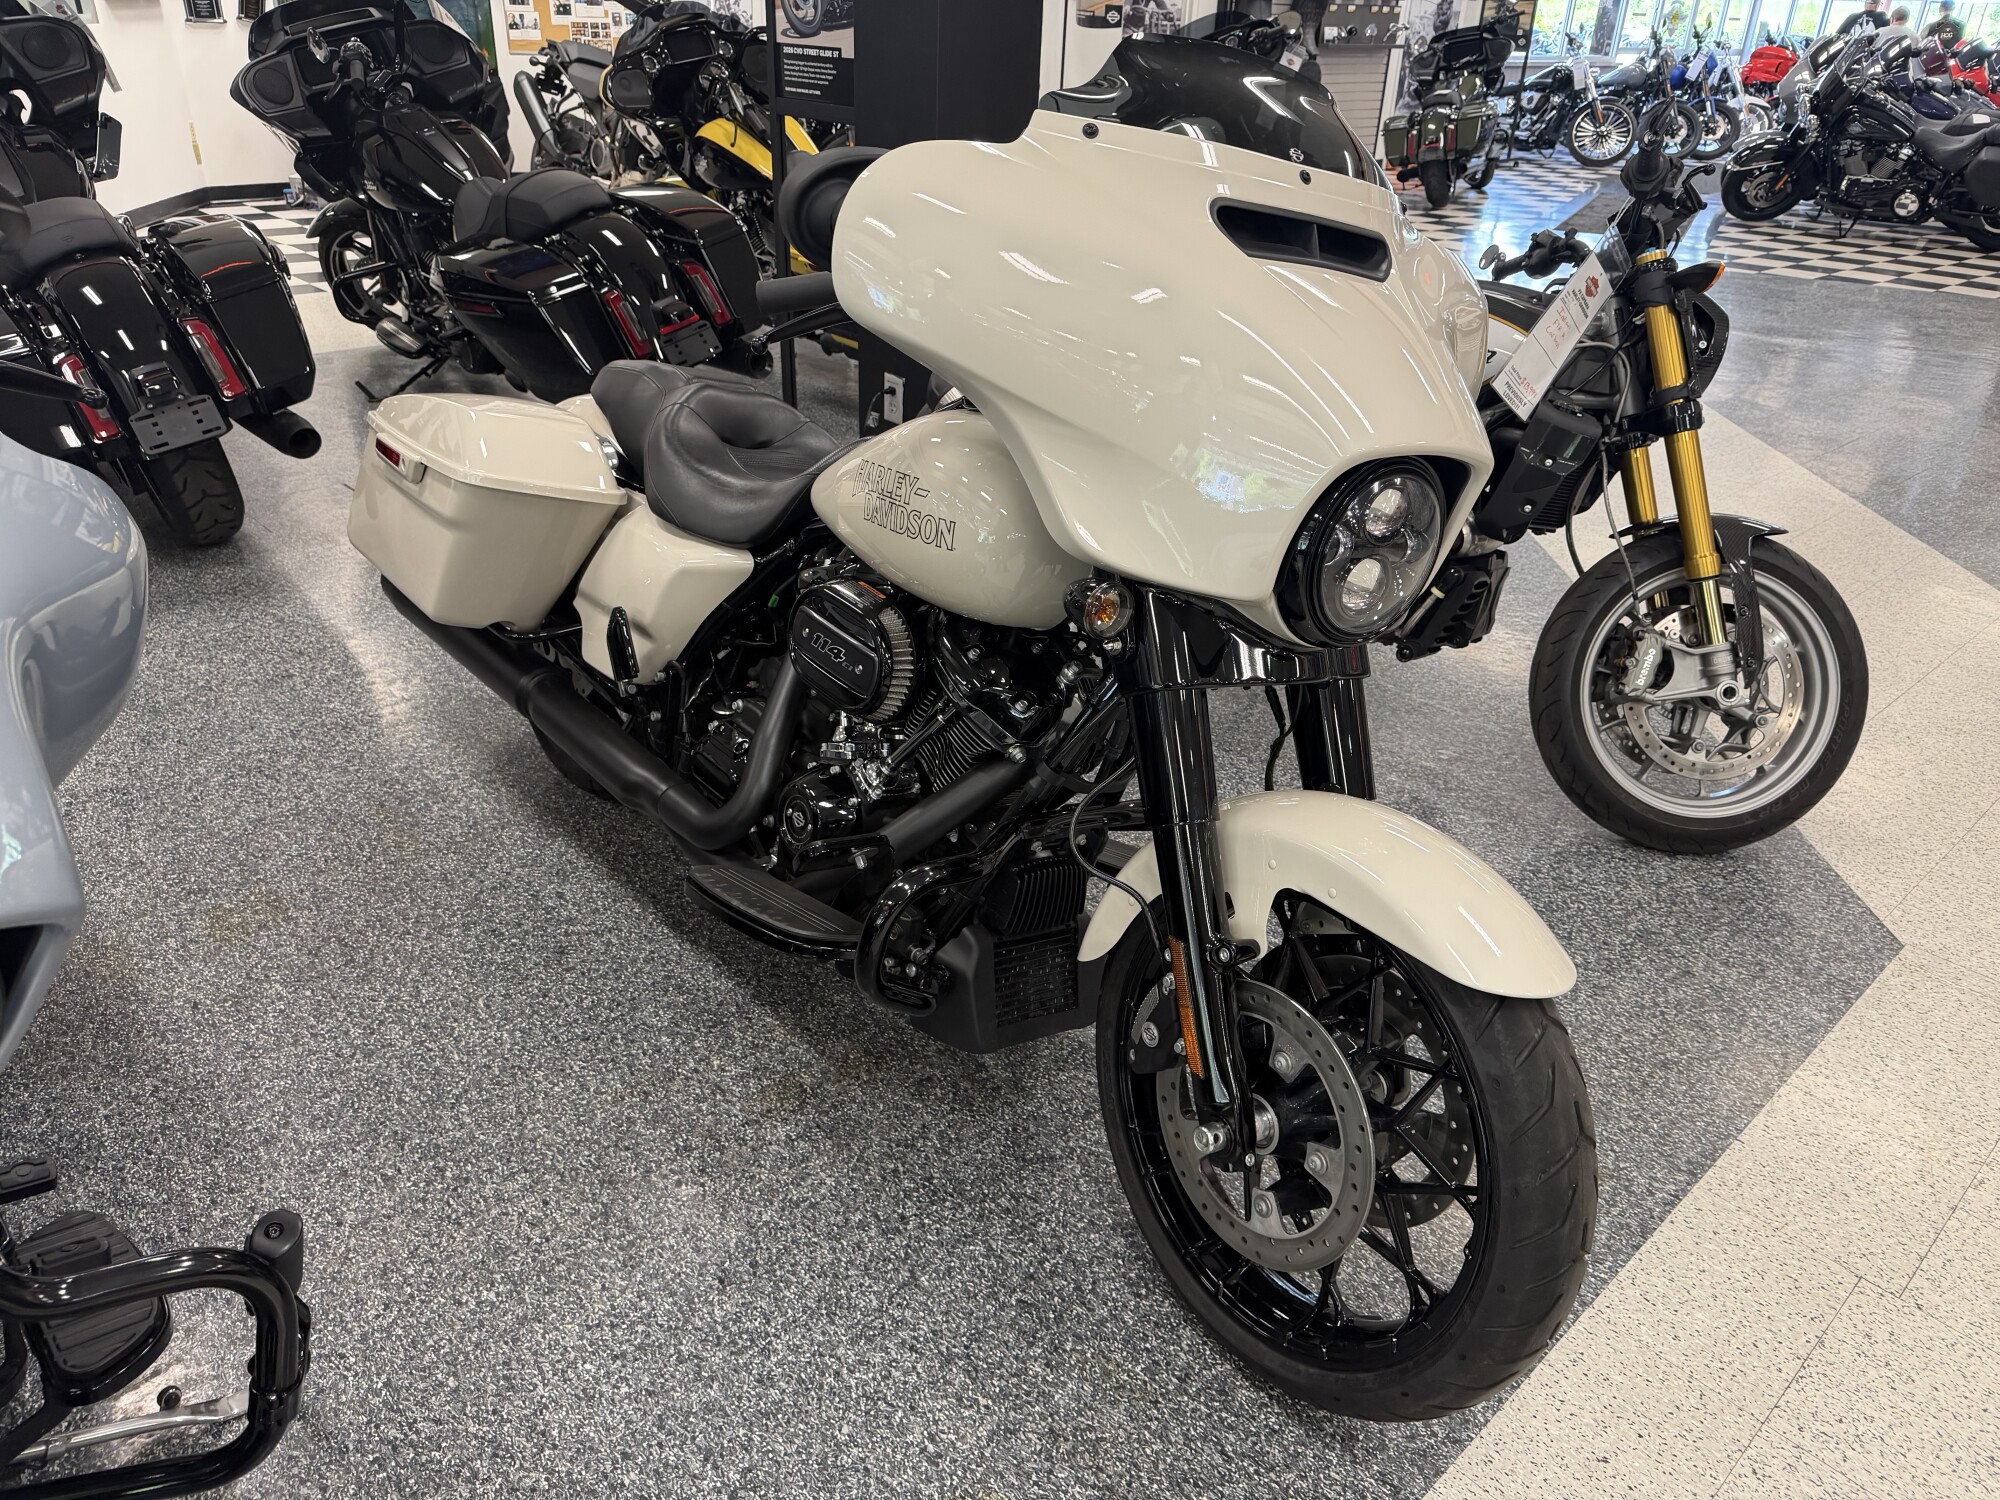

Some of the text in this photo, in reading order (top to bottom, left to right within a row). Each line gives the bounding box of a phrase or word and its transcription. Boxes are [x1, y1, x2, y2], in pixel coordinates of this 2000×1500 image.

[793, 47, 803, 55] CVO
[803, 48, 819, 56] STREET
[819, 49, 832, 57] GLIDE
[1504, 380, 1527, 408] PREVIOUSLY
[852, 458, 931, 506] HARLEY-
[863, 492, 956, 552] DAVIDSON
[810, 632, 846, 662] 114
[1635, 648, 1656, 686] brembo
